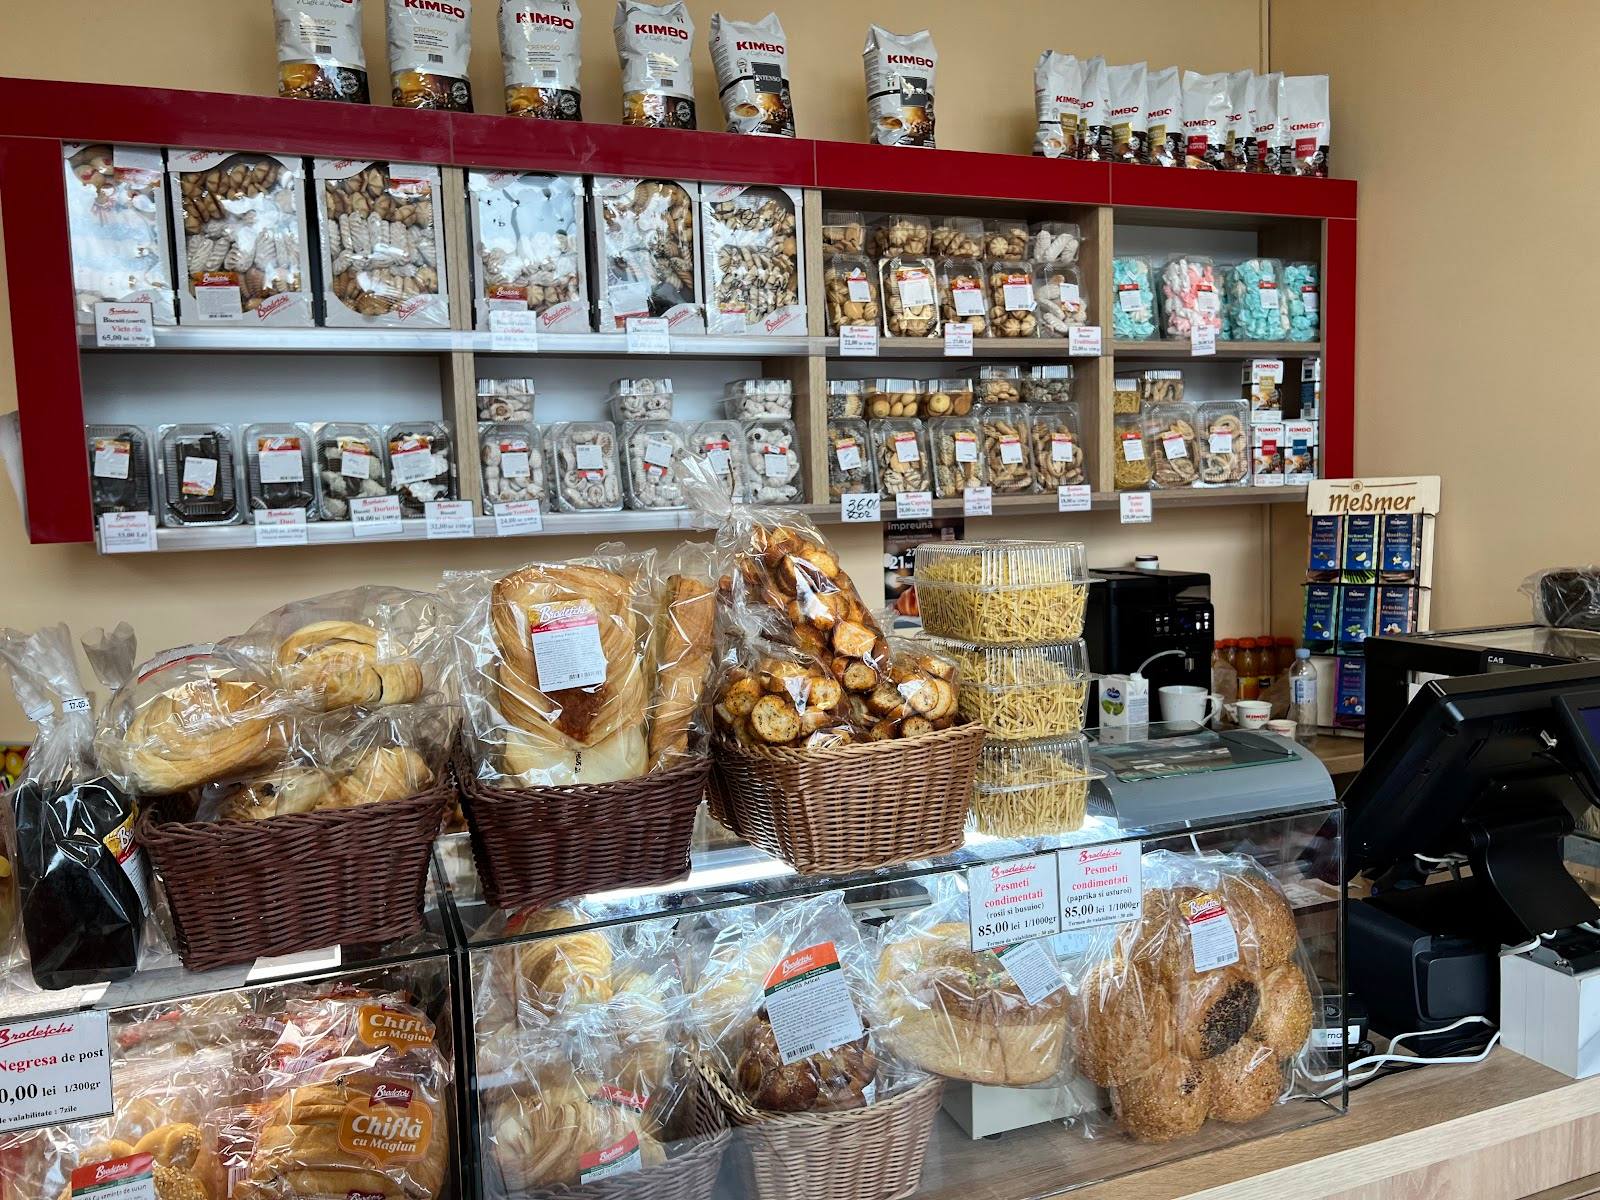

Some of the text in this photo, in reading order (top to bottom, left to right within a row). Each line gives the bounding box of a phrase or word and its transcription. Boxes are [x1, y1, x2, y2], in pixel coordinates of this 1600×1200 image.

[404, 0, 465, 19] KIMBO
[516, 12, 574, 30] KIMBO
[635, 24, 689, 40] KIMBO
[736, 40, 785, 55] KIMBO
[887, 54, 934, 68] KIMBO
[1111, 106, 1139, 117] IMBO
[1329, 493, 1415, 512] Meßmer
[889, 555, 904, 570] 21
[1488, 656, 1504, 664] CAS
[1085, 863, 1118, 876] Pesmeti
[995, 880, 1030, 893] Pesmeti
[1072, 875, 1129, 891] condimentati
[984, 889, 1044, 908] condimentati
[1066, 893, 1097, 904] (paprika
[986, 908, 1005, 920] (rosii
[1015, 902, 1044, 914] busuioc)
[1096, 905, 1105, 913] lei
[1109, 901, 1141, 912] 1/1000gr
[978, 916, 1057, 938] 85,00 lei 1/1000gr
[373, 1030, 387, 1039] cu
[61, 1052, 76, 1063] de
[80, 1047, 104, 1063] post
[42, 1085, 56, 1097] lei
[64, 1081, 101, 1094] 1/300gr
[9, 1110, 52, 1122] valabilitate
[59, 1104, 77, 1114] 7zile
[352, 1114, 424, 1140] Chiflă
[352, 1137, 417, 1153] cu Magiun
